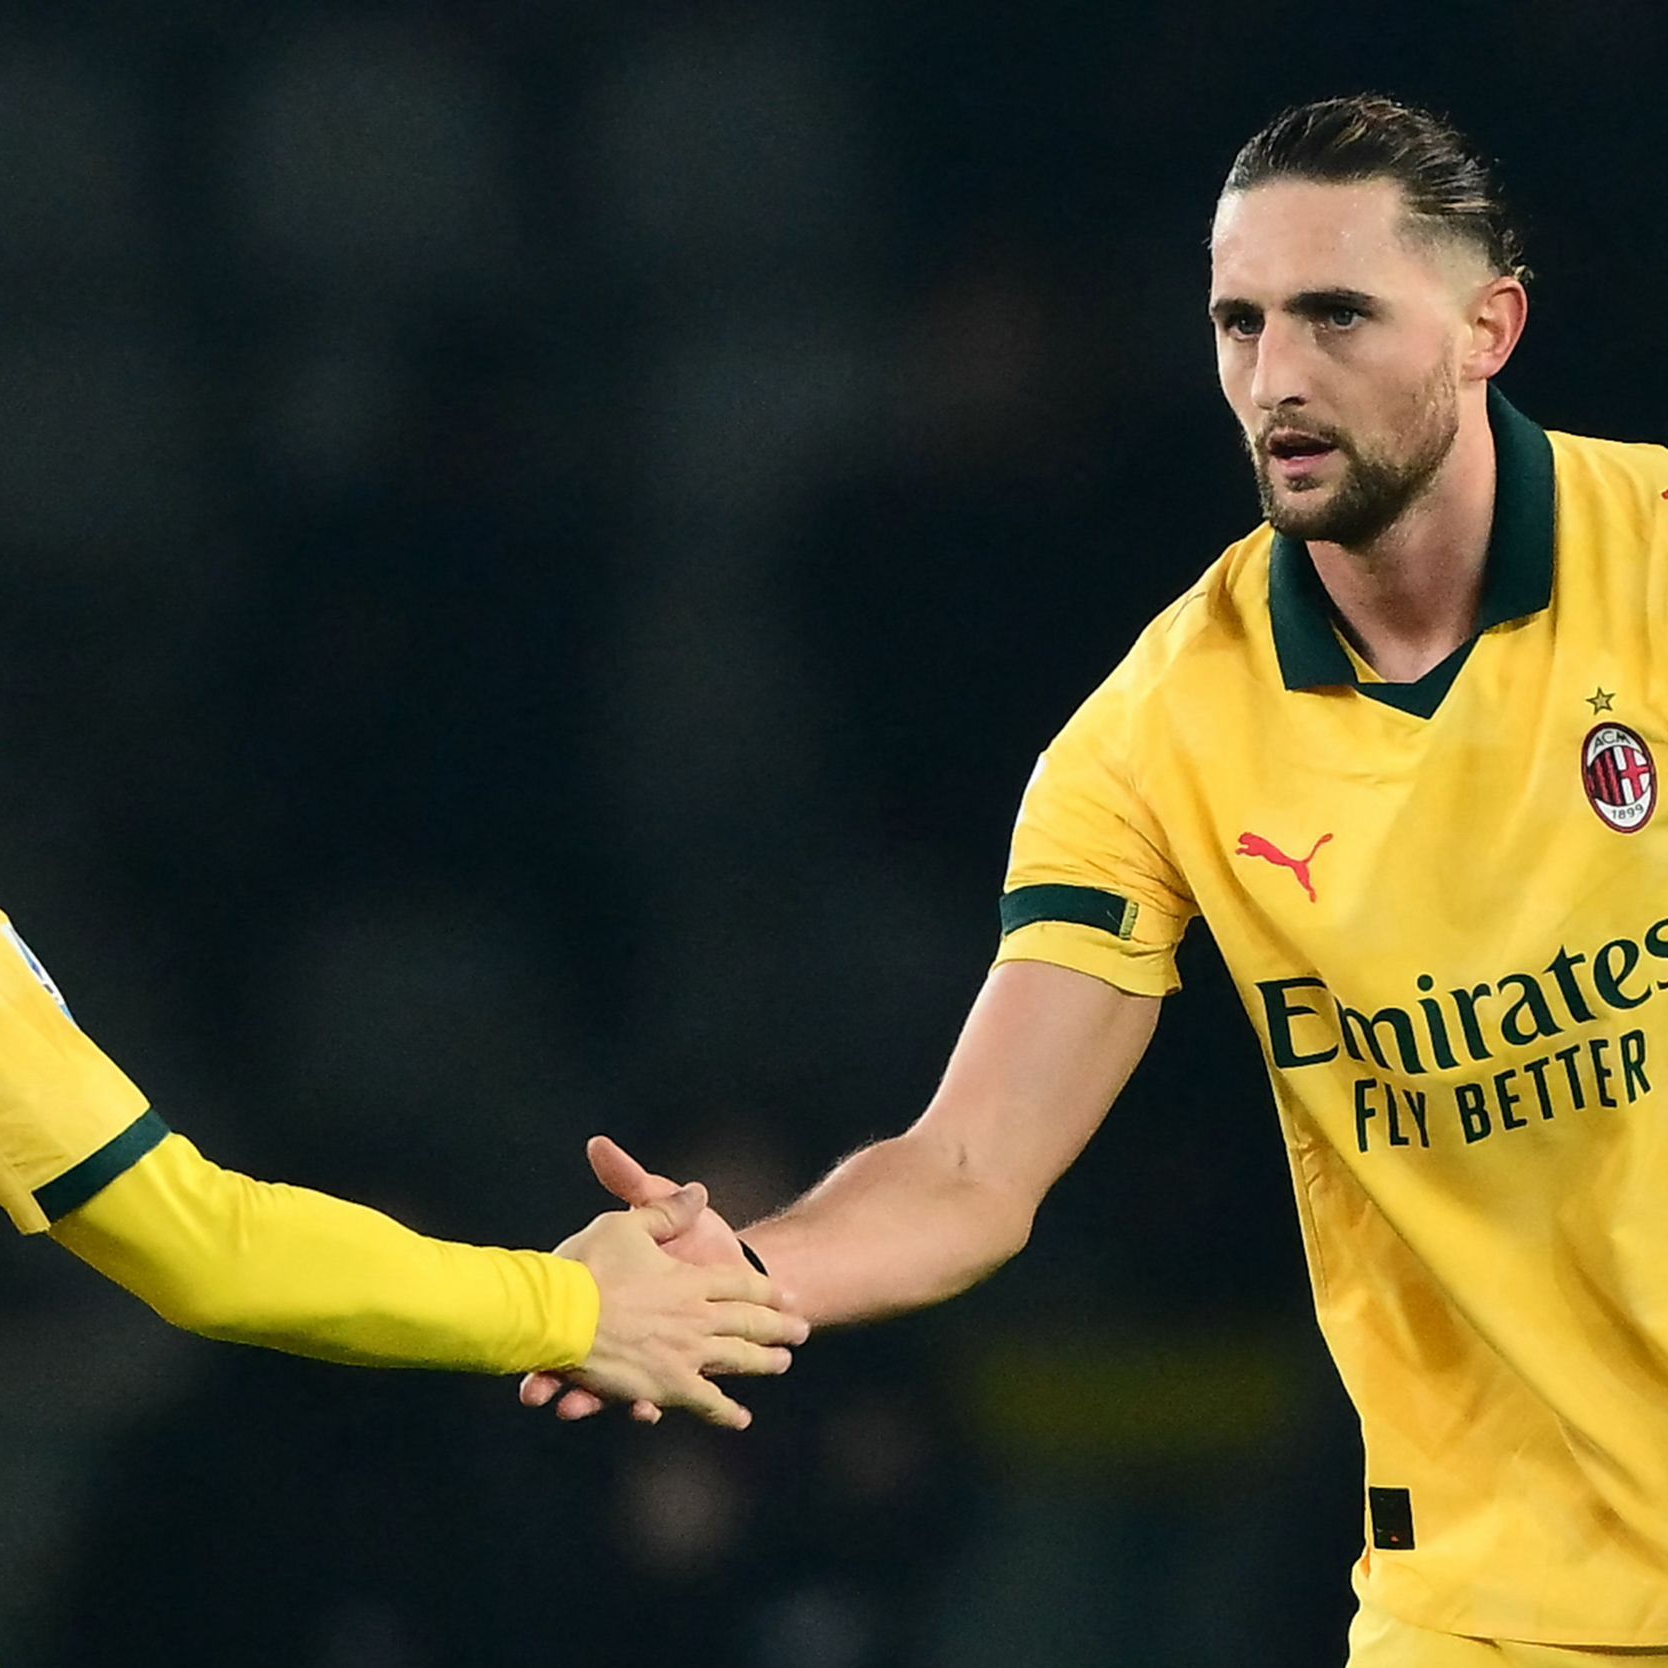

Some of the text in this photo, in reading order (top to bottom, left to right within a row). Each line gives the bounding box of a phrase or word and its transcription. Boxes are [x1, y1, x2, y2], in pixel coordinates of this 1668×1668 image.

[1592, 730, 1631, 750] ACM
[1611, 803, 1644, 820] 1899
[1353, 1029, 1652, 1153] FLY BETTER
